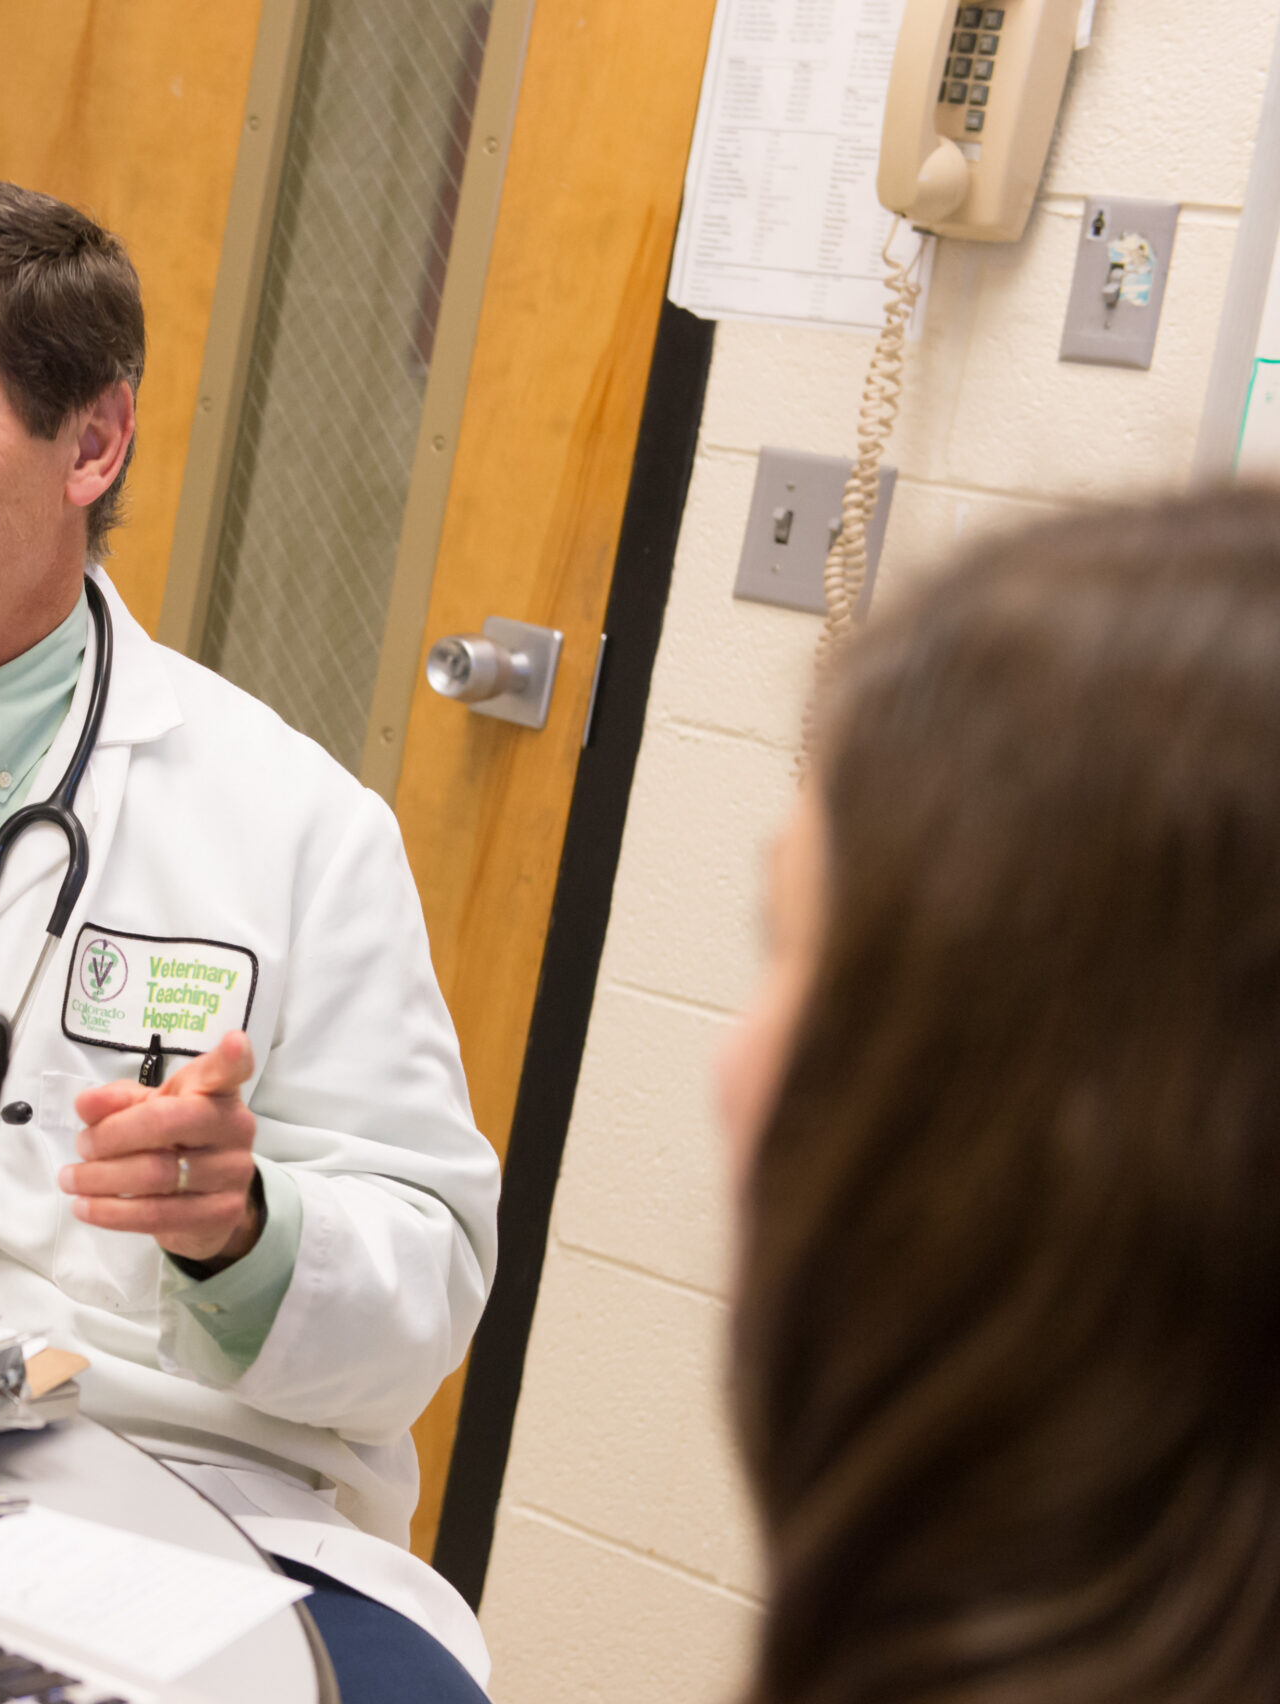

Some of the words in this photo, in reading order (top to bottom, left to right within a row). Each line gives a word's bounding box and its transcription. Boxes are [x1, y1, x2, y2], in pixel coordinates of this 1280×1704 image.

[149, 955, 238, 991] Veterinary
[71, 998, 126, 1020] Colorado
[146, 982, 220, 1014] Teaching
[80, 1012, 111, 1027] State
[142, 1007, 207, 1033] Hospital
